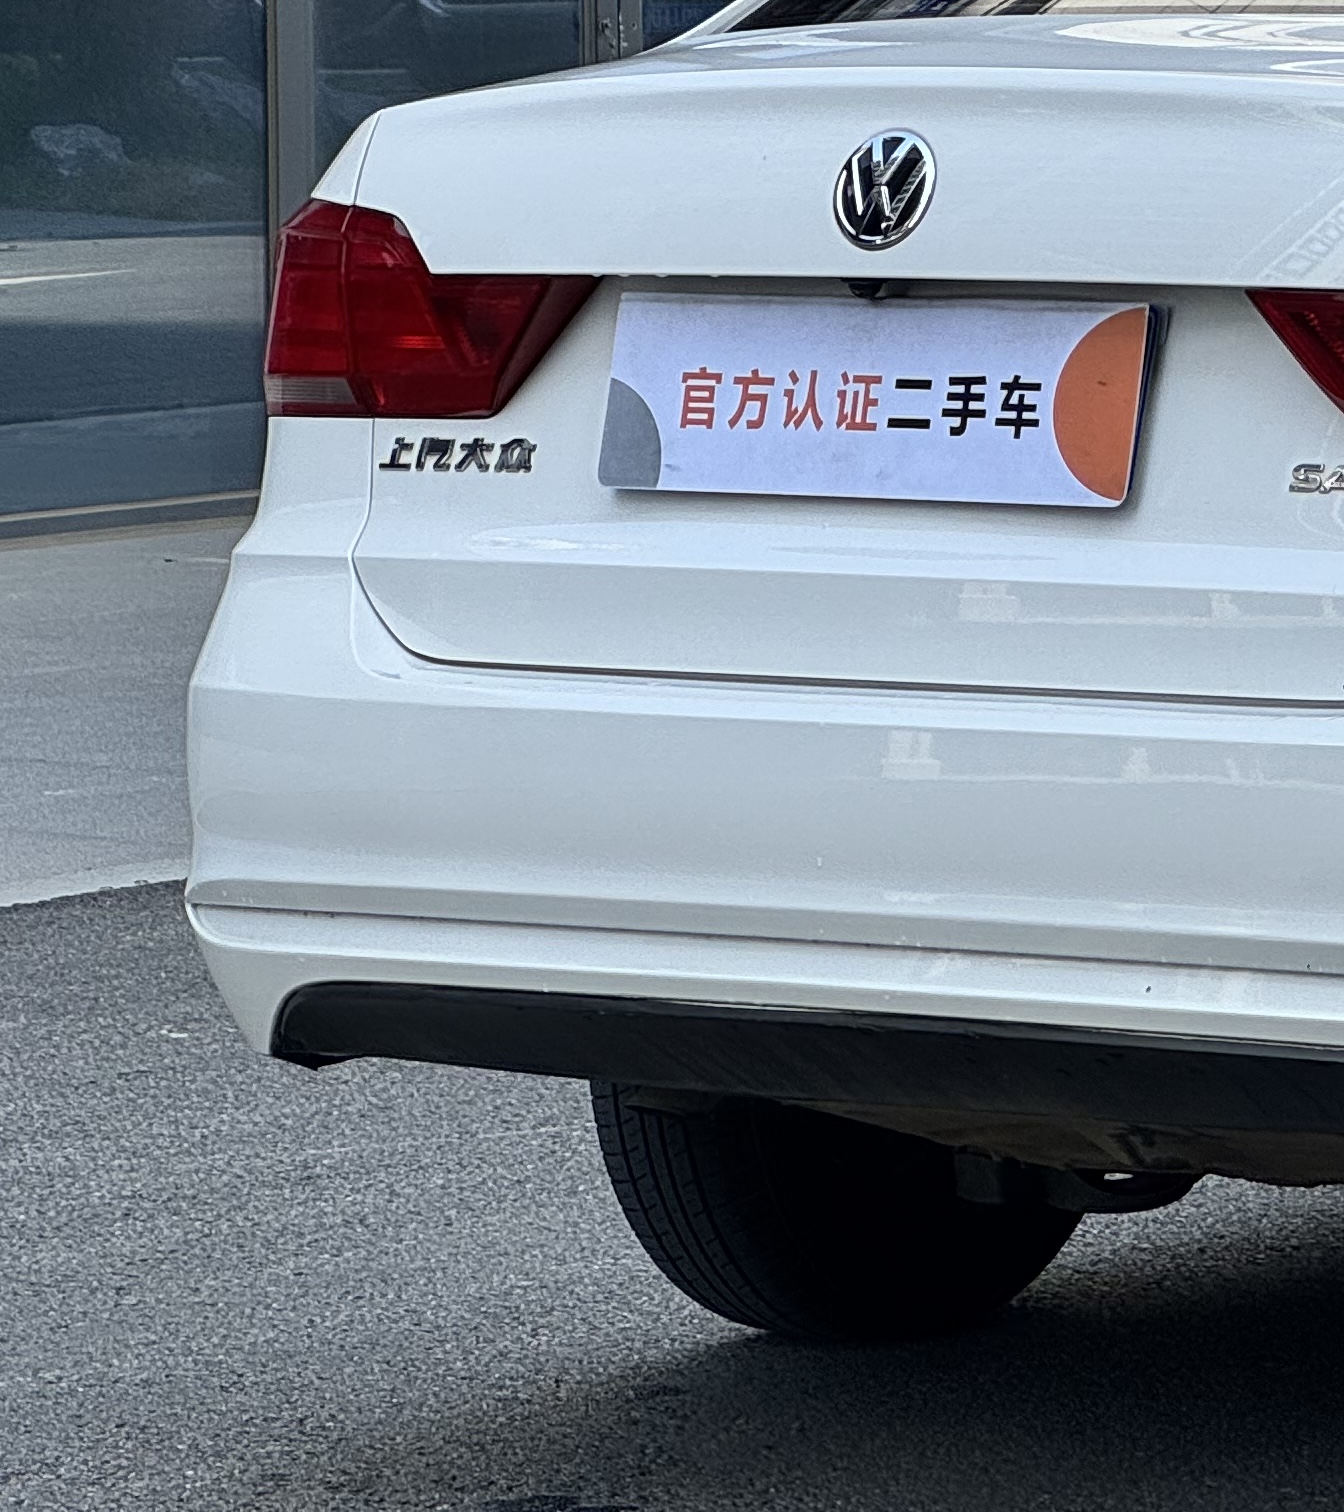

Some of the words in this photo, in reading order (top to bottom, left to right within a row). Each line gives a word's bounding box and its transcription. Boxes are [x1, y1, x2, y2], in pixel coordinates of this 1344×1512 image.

[678, 366, 1043, 440] 官方认证二手车
[378, 436, 537, 473] 上汽大众
